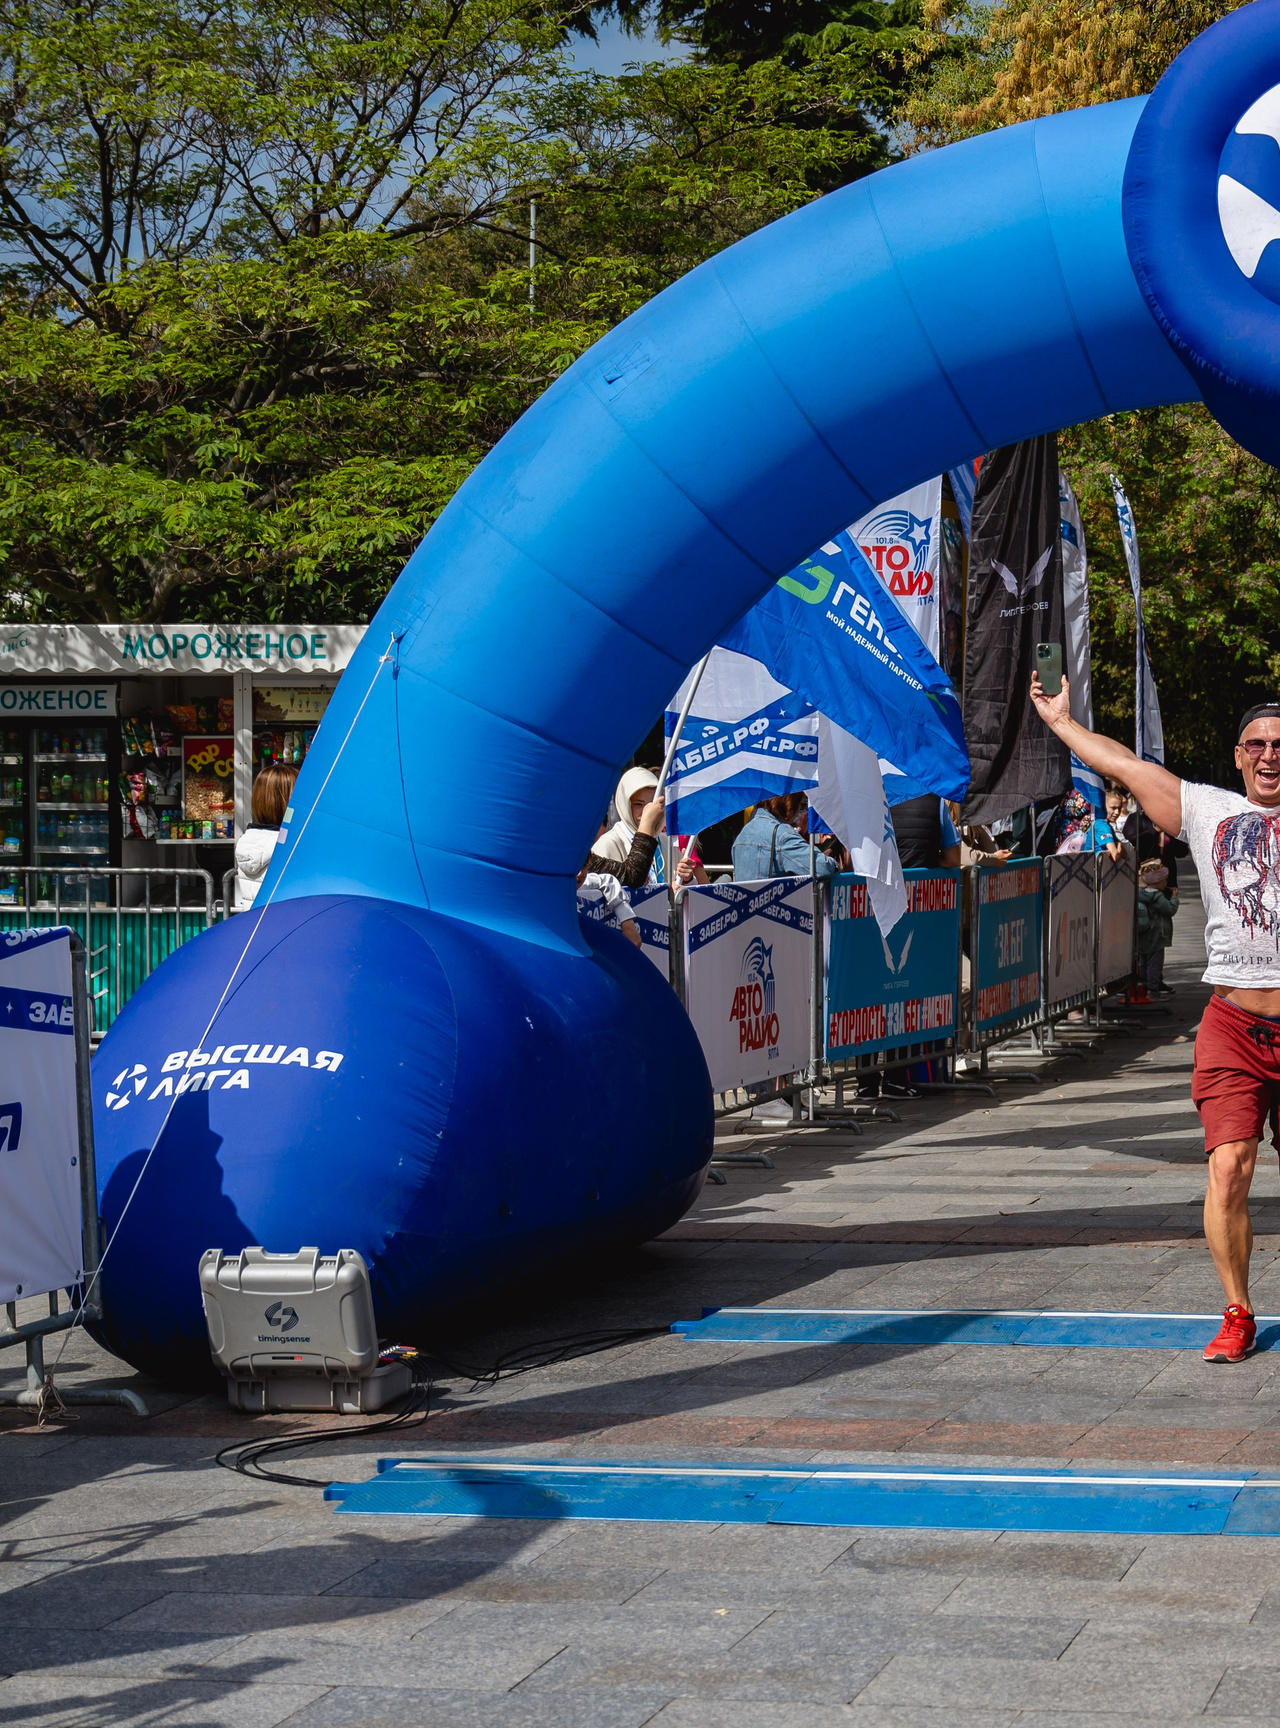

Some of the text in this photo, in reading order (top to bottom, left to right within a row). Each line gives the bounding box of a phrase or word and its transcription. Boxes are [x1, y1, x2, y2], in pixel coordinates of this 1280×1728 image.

[122, 634, 327, 660] МОРОЖЕНОЕ
[826, 610, 923, 691] МОЙ НАДЕЖНЫЙ ПАРТНЕР
[0, 689, 108, 711] ОЖЕНОЕ
[666, 716, 770, 780] АБЕГ.РФ
[748, 882, 785, 913] ЗАБЕГ.РФ
[915, 877, 957, 913] #МОМЕНТ
[699, 909, 739, 942] ЗАБЕГ.РФ
[1222, 952, 1273, 965] PHILIPP
[729, 983, 763, 1022] АВТО
[739, 1012, 780, 1054] РАДИО
[829, 1004, 886, 1049] #ГОРДОСТЬ
[921, 993, 954, 1030] #МЕЧТА
[161, 1044, 344, 1073] ВЫСШАЯ
[147, 1069, 250, 1101] ЛИГА
[258, 1335, 311, 1344] timingsense
